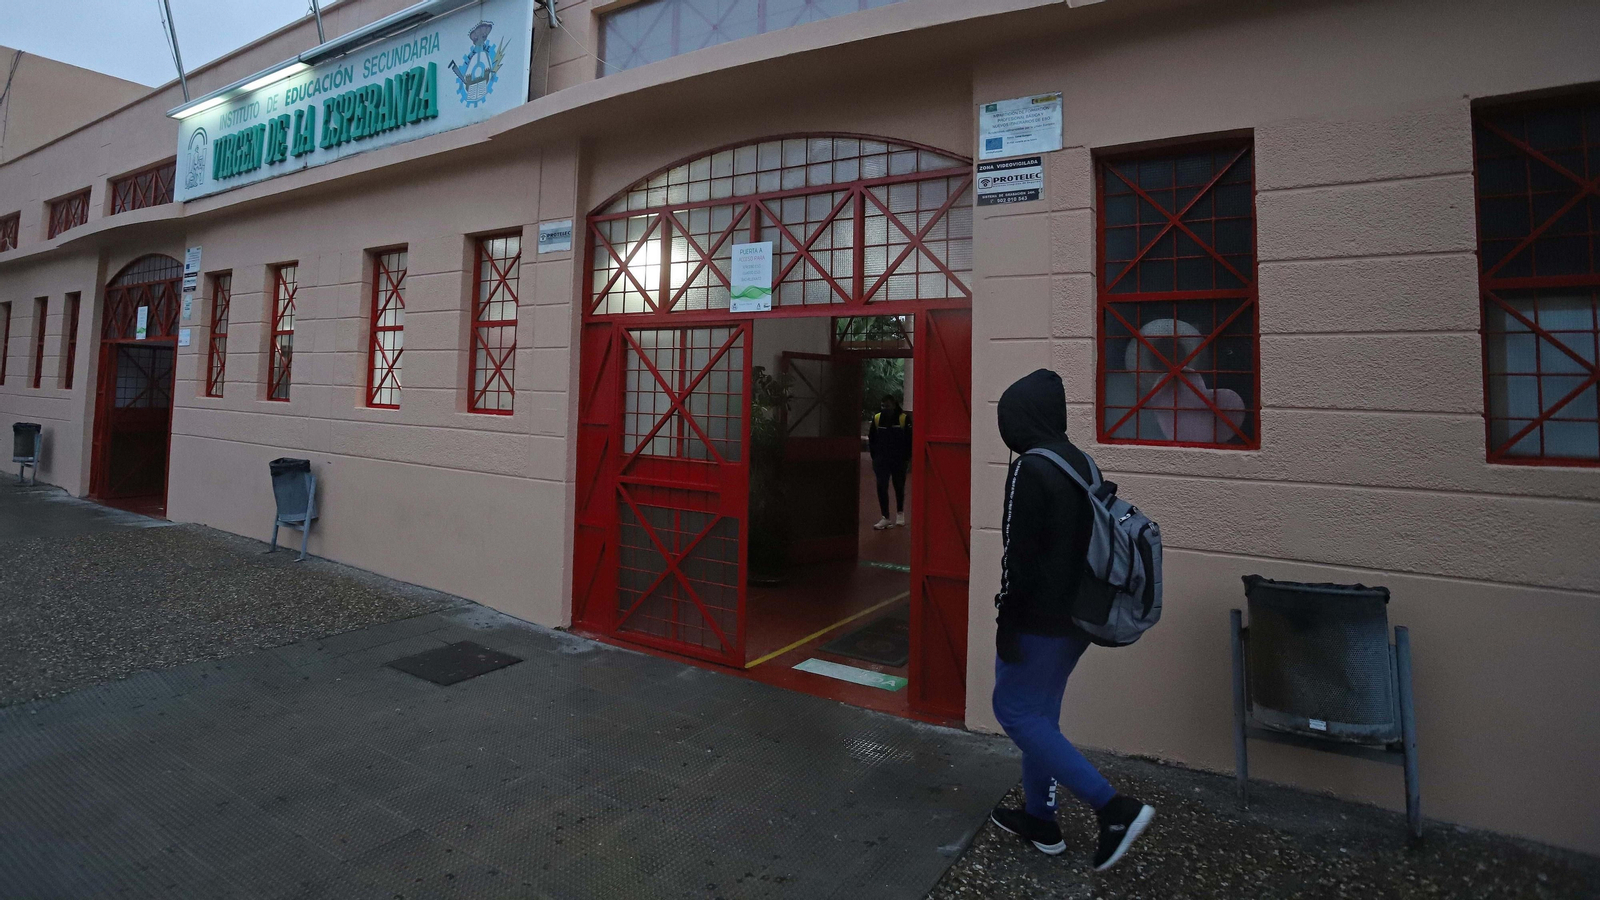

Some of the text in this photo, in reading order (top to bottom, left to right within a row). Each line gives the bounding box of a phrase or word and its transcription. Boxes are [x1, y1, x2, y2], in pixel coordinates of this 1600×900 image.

[219, 104, 260, 131] INSTITUTO
[266, 94, 278, 115] DE
[285, 64, 353, 106] EDUCACIÓN
[363, 32, 440, 79] SECUNDARIA
[212, 61, 439, 181] VIRGEN DE LA ESPERANZA
[993, 173, 1041, 183] PROTELEC
[996, 159, 1038, 169] VIDEOVIGILADA
